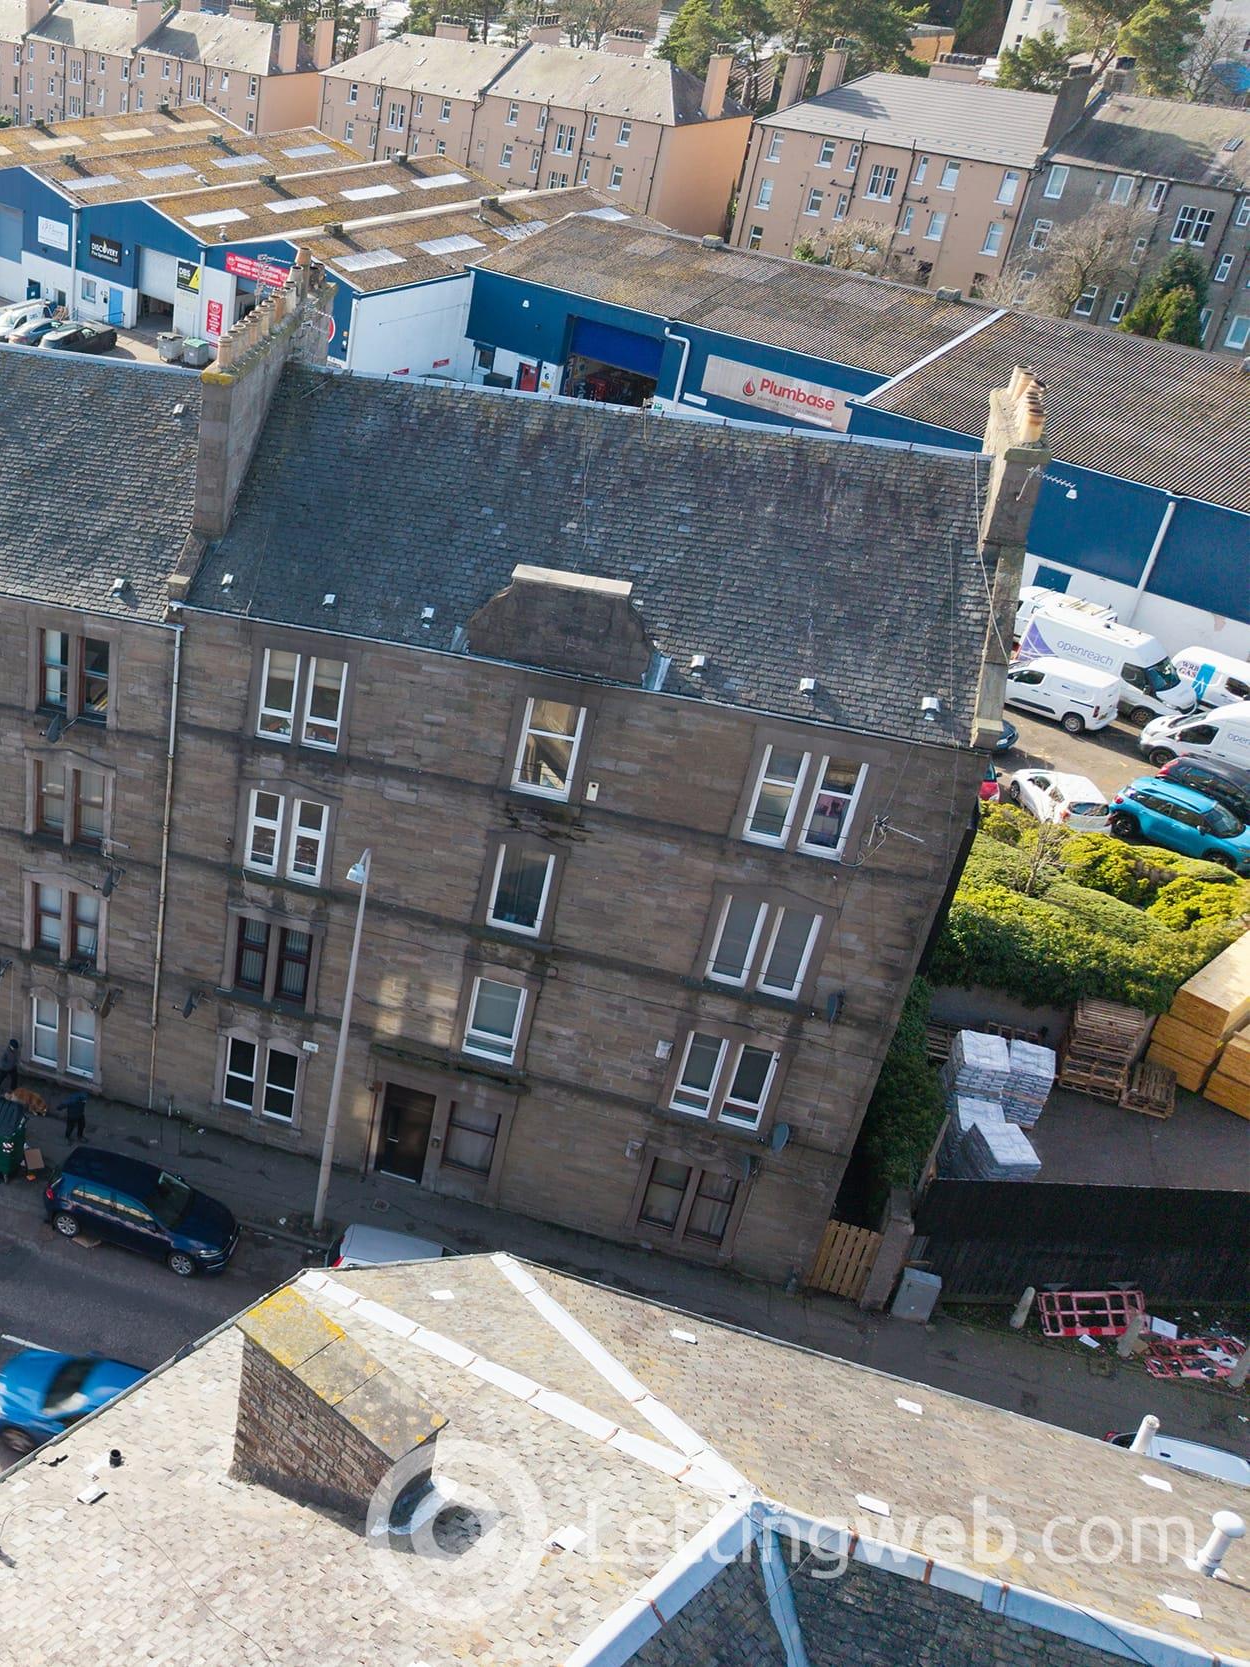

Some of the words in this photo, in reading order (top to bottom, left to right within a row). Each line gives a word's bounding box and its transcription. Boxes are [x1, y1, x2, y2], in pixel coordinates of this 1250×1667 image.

[544, 372, 550, 380] 6
[760, 377, 836, 412] Plumbase
[1056, 640, 1114, 666] openreach
[1179, 667, 1197, 678] GAS
